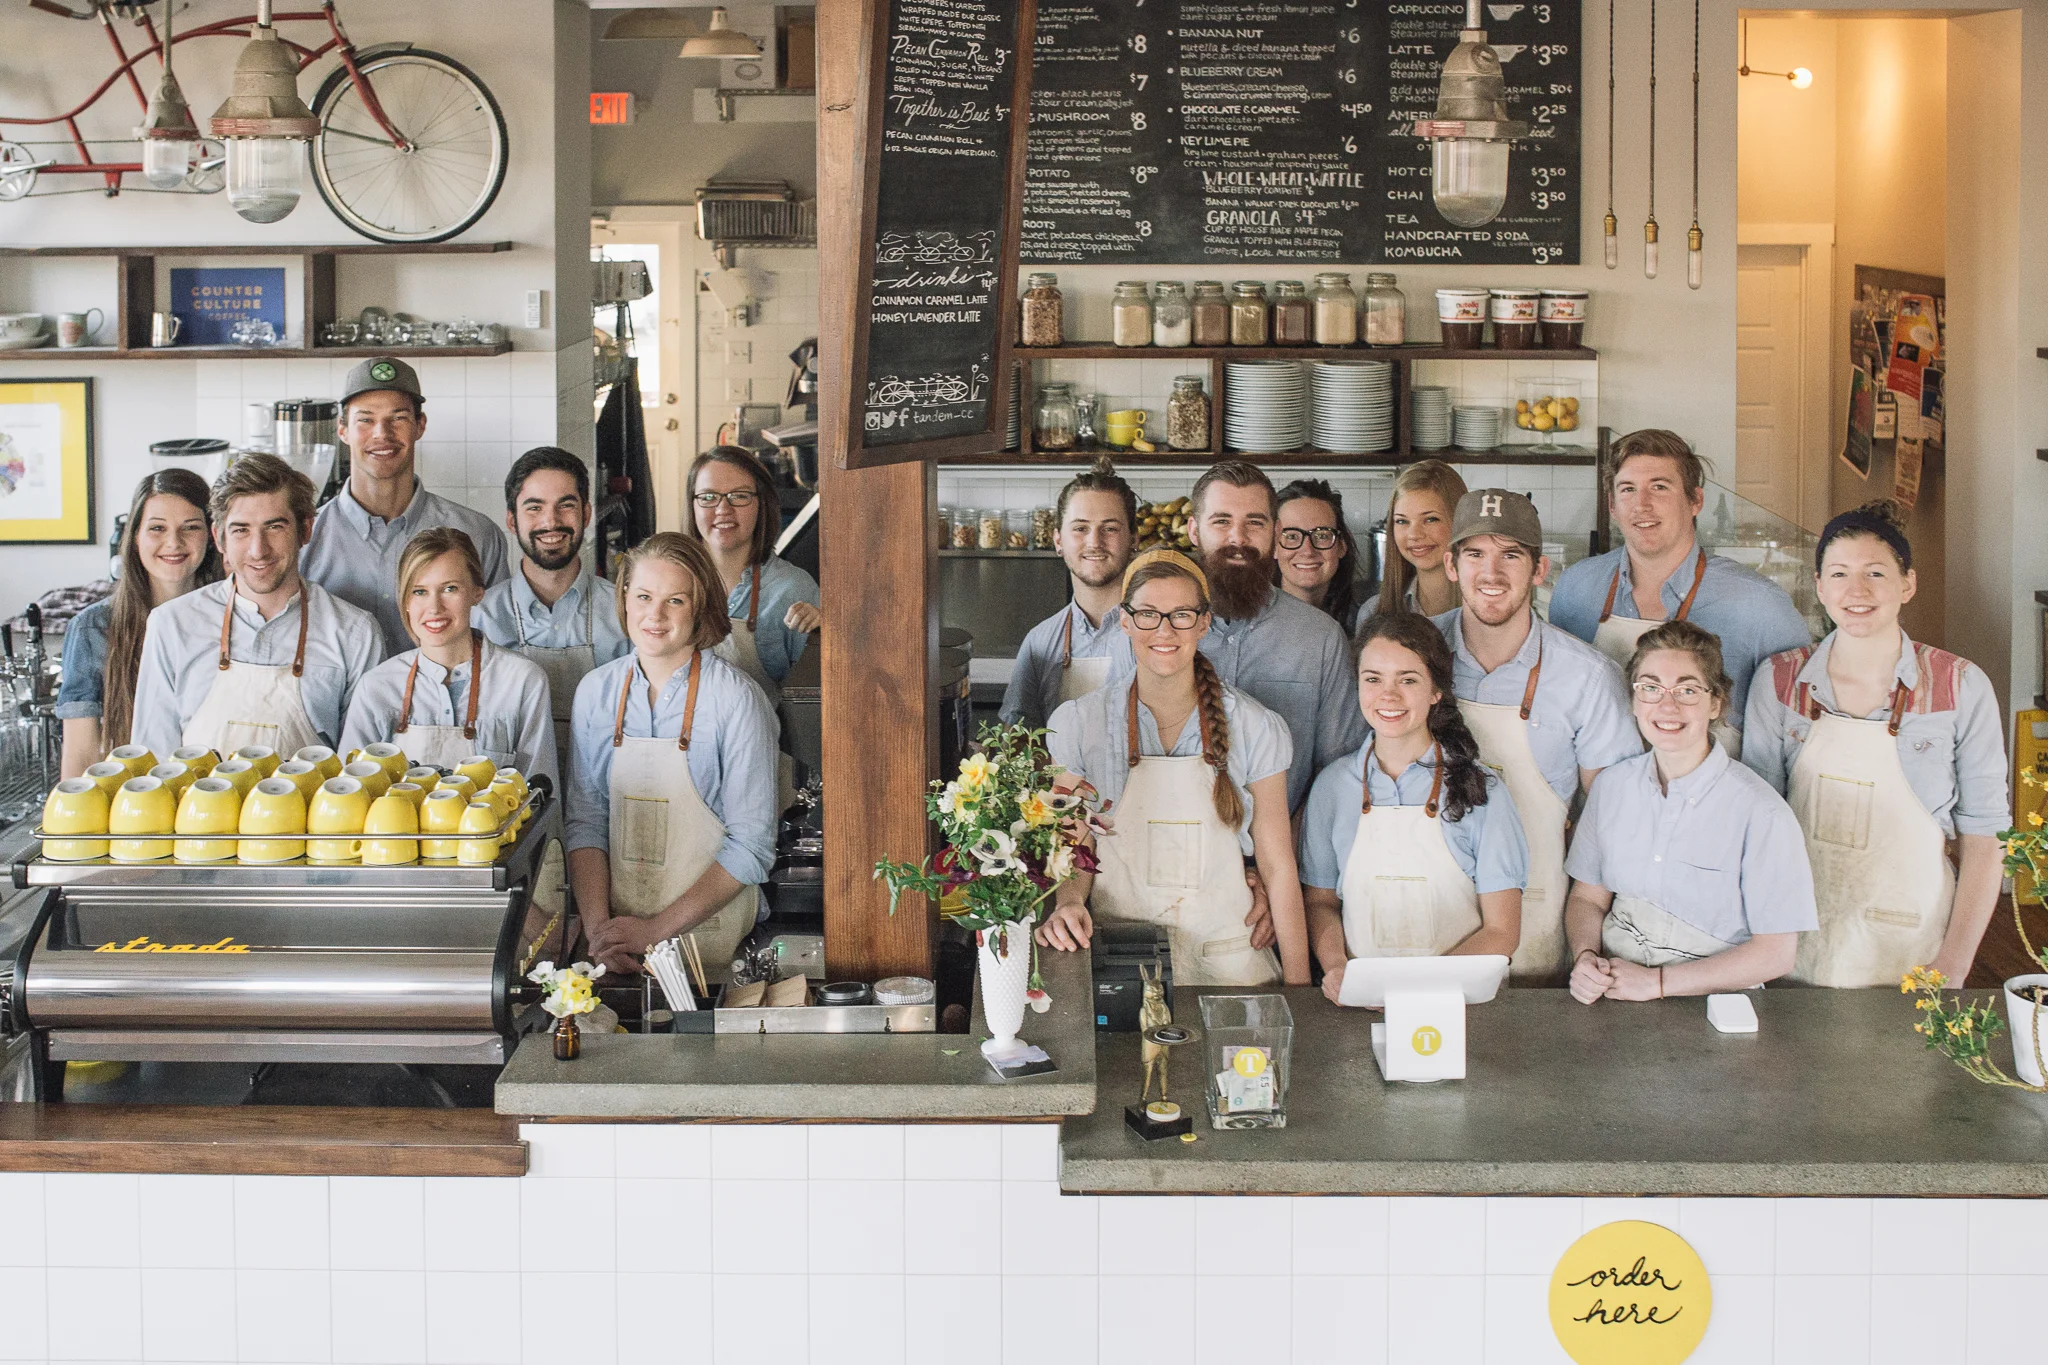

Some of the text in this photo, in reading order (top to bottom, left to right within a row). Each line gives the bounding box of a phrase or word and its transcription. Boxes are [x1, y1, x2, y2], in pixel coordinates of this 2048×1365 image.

[1388, 5, 1464, 15] CAPPUCCINO
[1179, 29, 1235, 38] BANANA
[1236, 29, 1264, 38] NUT
[1388, 45, 1435, 54] LATTE
[1180, 66, 1244, 77] BLUEBERRY
[1246, 67, 1283, 77] CREAM
[589, 92, 629, 124] EXIT
[889, 94, 947, 127] Together
[947, 105, 960, 119] is
[957, 101, 990, 123] Best
[1180, 105, 1241, 114] CHOCOLATE
[1251, 105, 1300, 114] CARAMEL
[1037, 112, 1110, 122] MUSHROOM
[886, 130, 975, 144] PECAN CINNAMON ROLL
[1180, 136, 1203, 146] KEY
[1204, 136, 1232, 146] LIME
[1233, 137, 1250, 147] PIE
[1221, 149, 1260, 158] custard
[1388, 167, 1417, 176] HOT
[1202, 170, 1364, 189] WHOLE WHEAT WAFFLE
[1205, 185, 1262, 195] BLUEBERRY
[1387, 191, 1423, 200] CHAI
[1115, 209, 1132, 218] egg
[1206, 210, 1281, 226] GRANOLA
[1385, 214, 1419, 224] TEA
[1023, 220, 1056, 230] ROOTS
[1385, 231, 1530, 241] HANDCRAFTED SODA
[1081, 241, 1111, 253] topped
[1385, 246, 1462, 257] KOMBUCHA
[889, 266, 975, 288] drinks
[191, 286, 263, 297] COUNTER
[193, 299, 262, 310] CULTURE
[872, 295, 988, 306] CINNAMON CARAMEL LATTE
[872, 311, 981, 323] HONEY LAVENDER LATTE
[1480, 494, 1502, 517] H
[94, 936, 250, 954] strada
[1417, 1032, 1436, 1051] T
[1241, 1053, 1260, 1073] T
[1567, 1256, 1682, 1291] order
[1573, 1299, 1683, 1325] here
